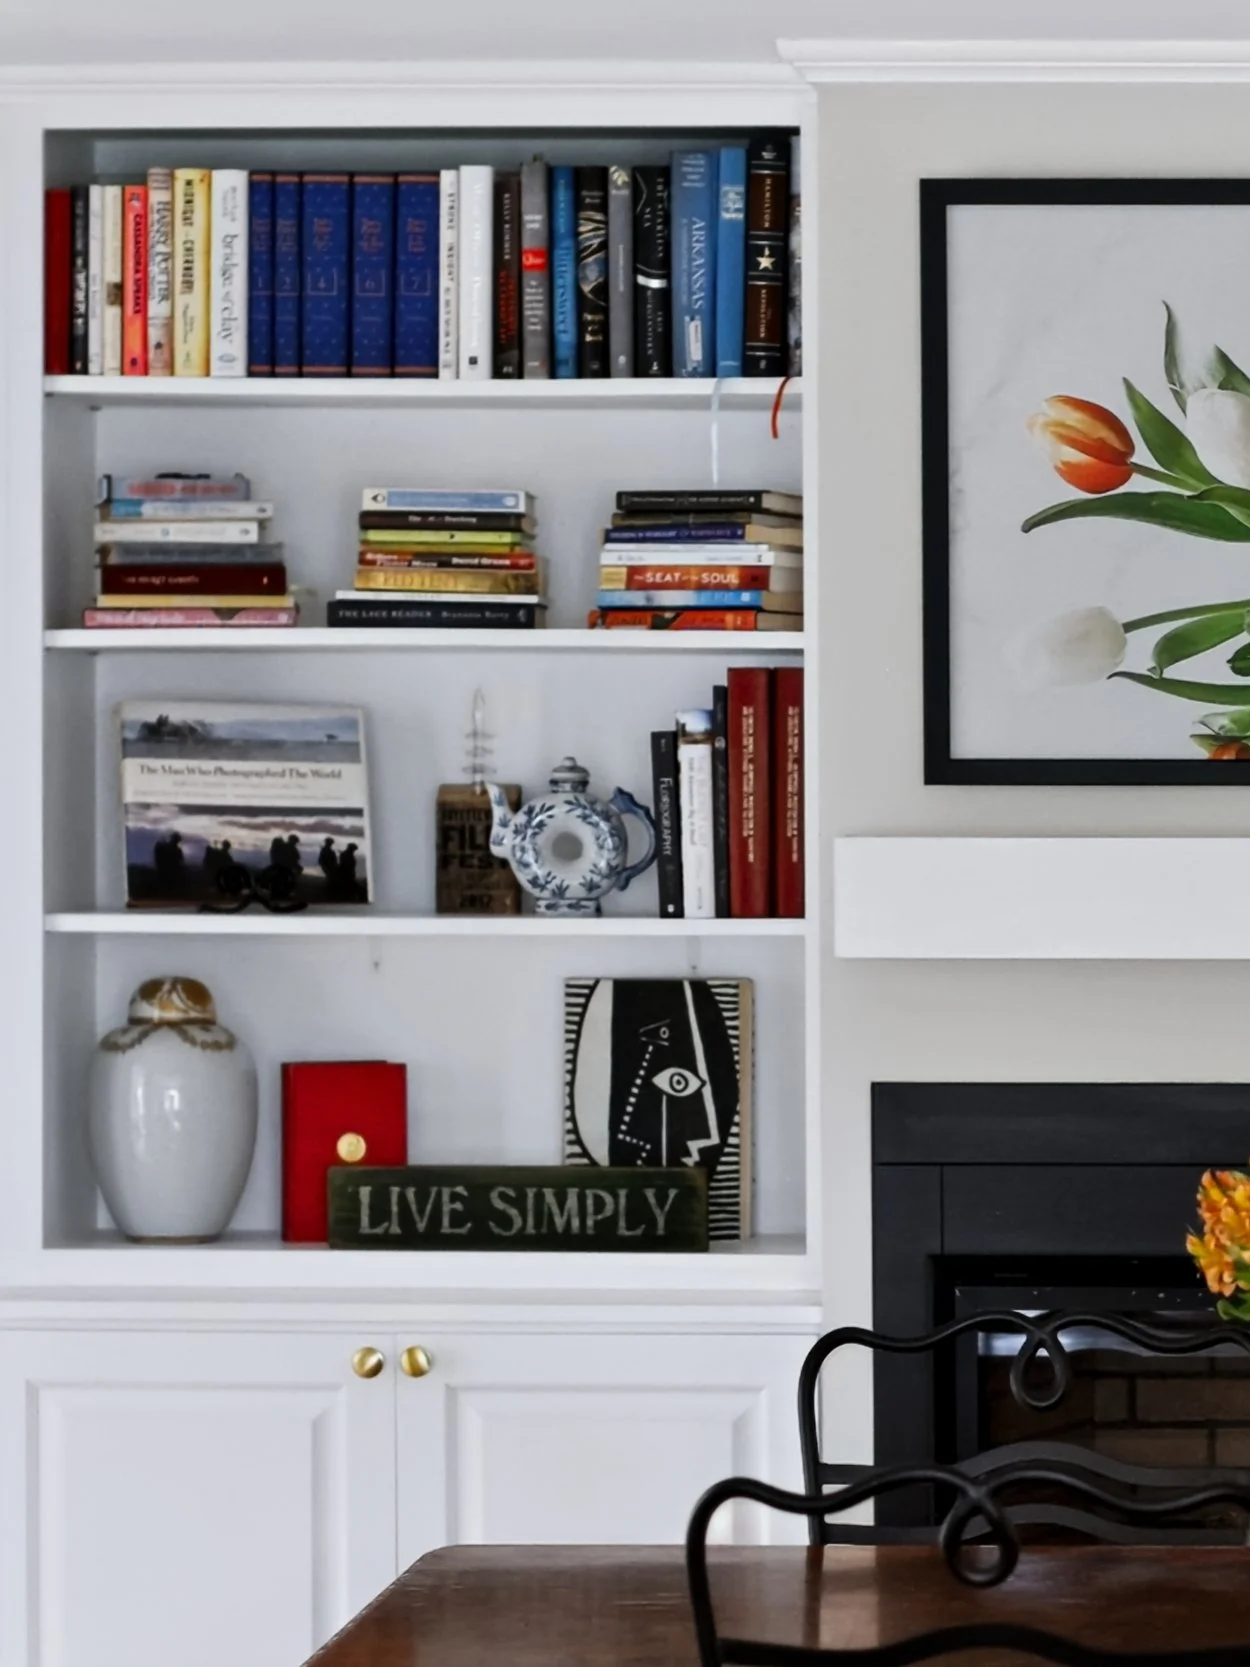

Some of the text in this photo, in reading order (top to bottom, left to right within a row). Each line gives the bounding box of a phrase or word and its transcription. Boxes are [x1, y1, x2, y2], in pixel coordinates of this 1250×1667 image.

[183, 179, 194, 227] MIDNIGHT
[503, 193, 511, 220] KELLY
[643, 207, 651, 228] SEA
[656, 177, 664, 258] THE STARLESS
[763, 178, 772, 228] HAMILTON
[133, 213, 142, 314] CASSANDRA SPEAKS
[156, 200, 172, 304] HARRY POTTER
[221, 233, 240, 288] bridge
[447, 192, 455, 282] STROKE INSIGHT
[691, 217, 706, 309] ARKANSAS
[180, 240, 195, 295] CHERNOBYL
[556, 245, 571, 337] Bittersweet
[217, 306, 239, 344] clay
[759, 289, 768, 338] REVOLUTION
[645, 572, 739, 584] SEAT SOUL
[338, 610, 358, 618] THE
[362, 610, 388, 618] LACE
[391, 610, 432, 618] READER
[138, 764, 158, 775] The
[288, 767, 308, 778] The
[311, 768, 342, 779] World
[659, 777, 673, 856] FLORIOGRAPHY
[358, 1184, 679, 1237] LIVE SIMPLY
